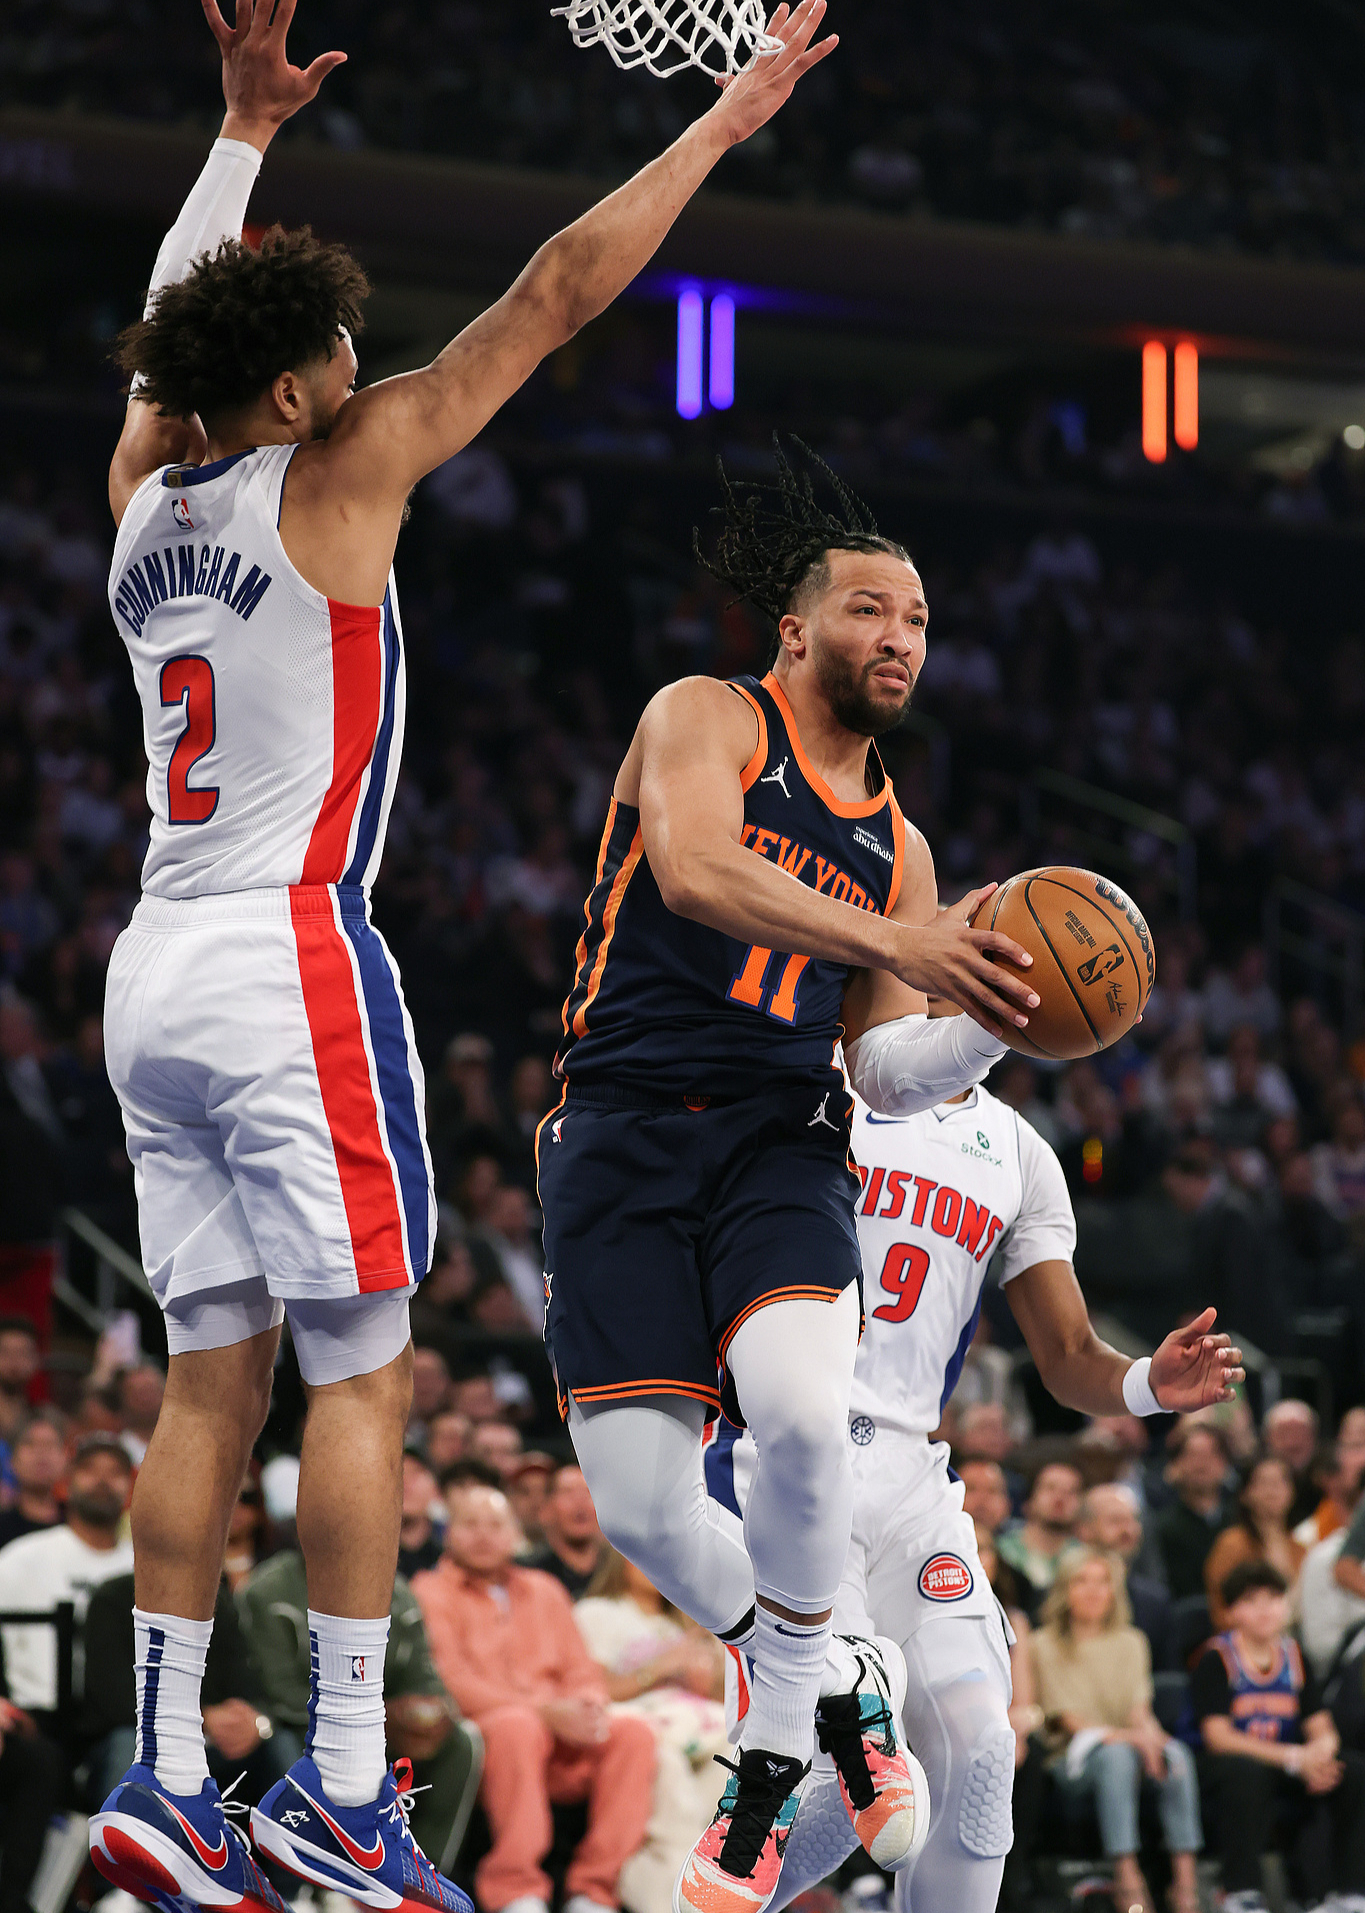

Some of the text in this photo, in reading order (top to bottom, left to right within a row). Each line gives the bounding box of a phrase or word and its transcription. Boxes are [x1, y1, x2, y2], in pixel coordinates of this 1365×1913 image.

[115, 544, 273, 638] CUNNINGHAM
[159, 654, 220, 826] 2
[852, 832, 895, 865] abu dhabi
[725, 943, 812, 1028] 11
[871, 1242, 931, 1325] 9
[927, 1568, 963, 1580] DETROIT
[928, 1576, 966, 1590] PISTONS
